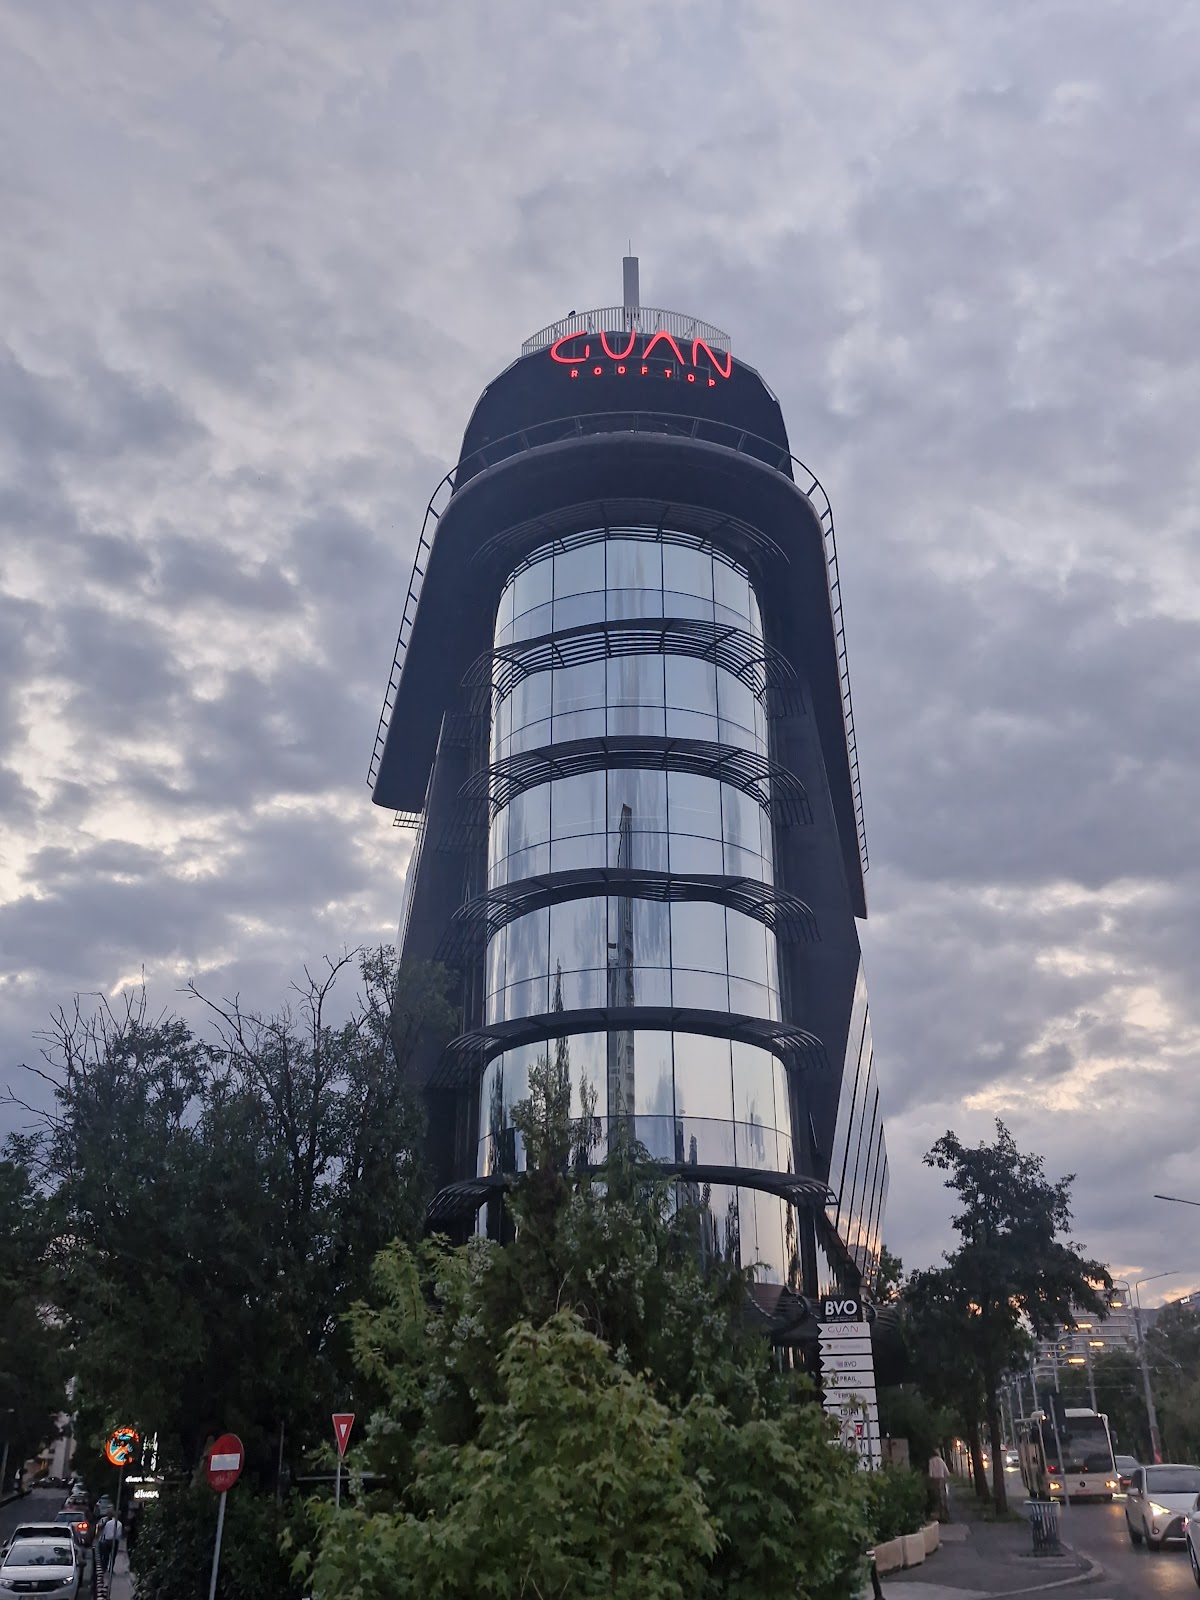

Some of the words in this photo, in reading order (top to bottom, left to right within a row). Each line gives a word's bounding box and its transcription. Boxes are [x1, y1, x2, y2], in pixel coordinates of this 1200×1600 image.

[549, 329, 732, 379] GUAN
[570, 366, 717, 387] ROOFTOP
[825, 1300, 858, 1316] BVO
